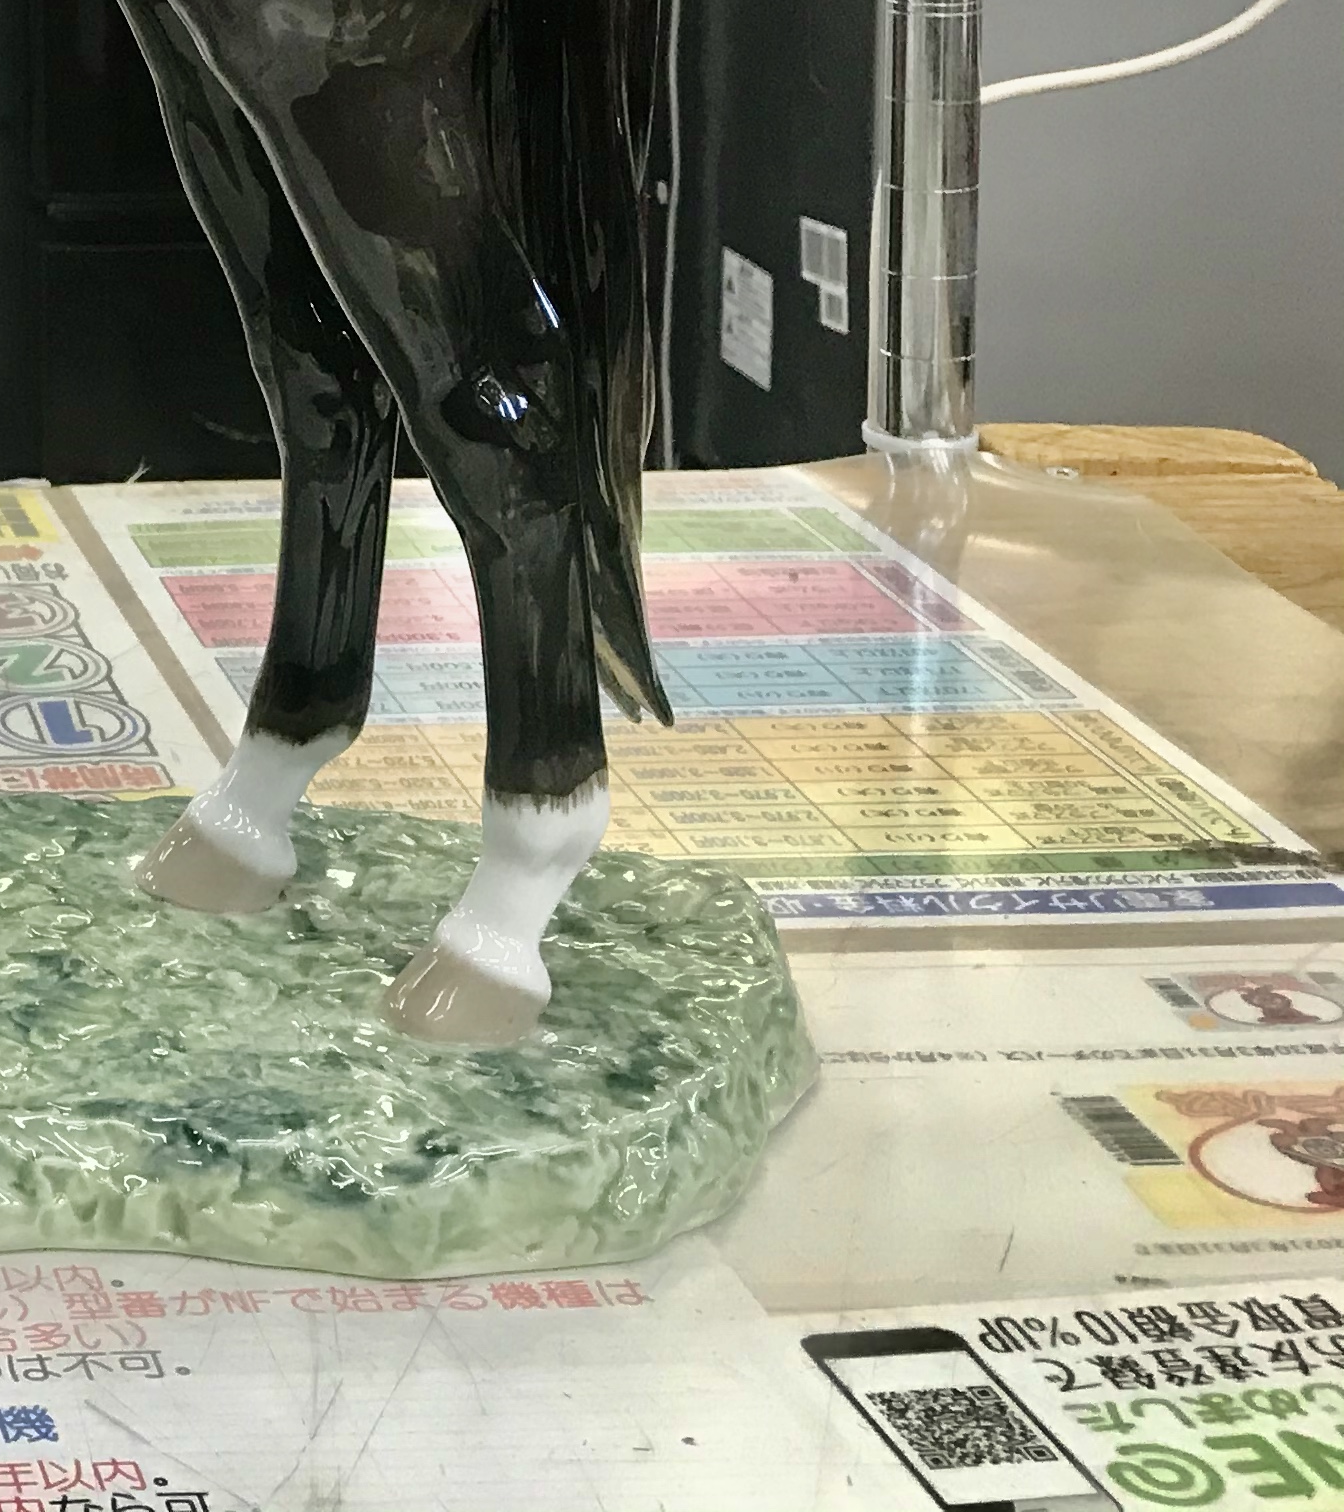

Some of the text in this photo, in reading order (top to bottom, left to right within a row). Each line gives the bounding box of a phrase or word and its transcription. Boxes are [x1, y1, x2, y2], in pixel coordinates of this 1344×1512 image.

[764, 889, 1216, 917] 家電リサイクル料金・収
[1062, 1382, 1344, 1438] じめました
